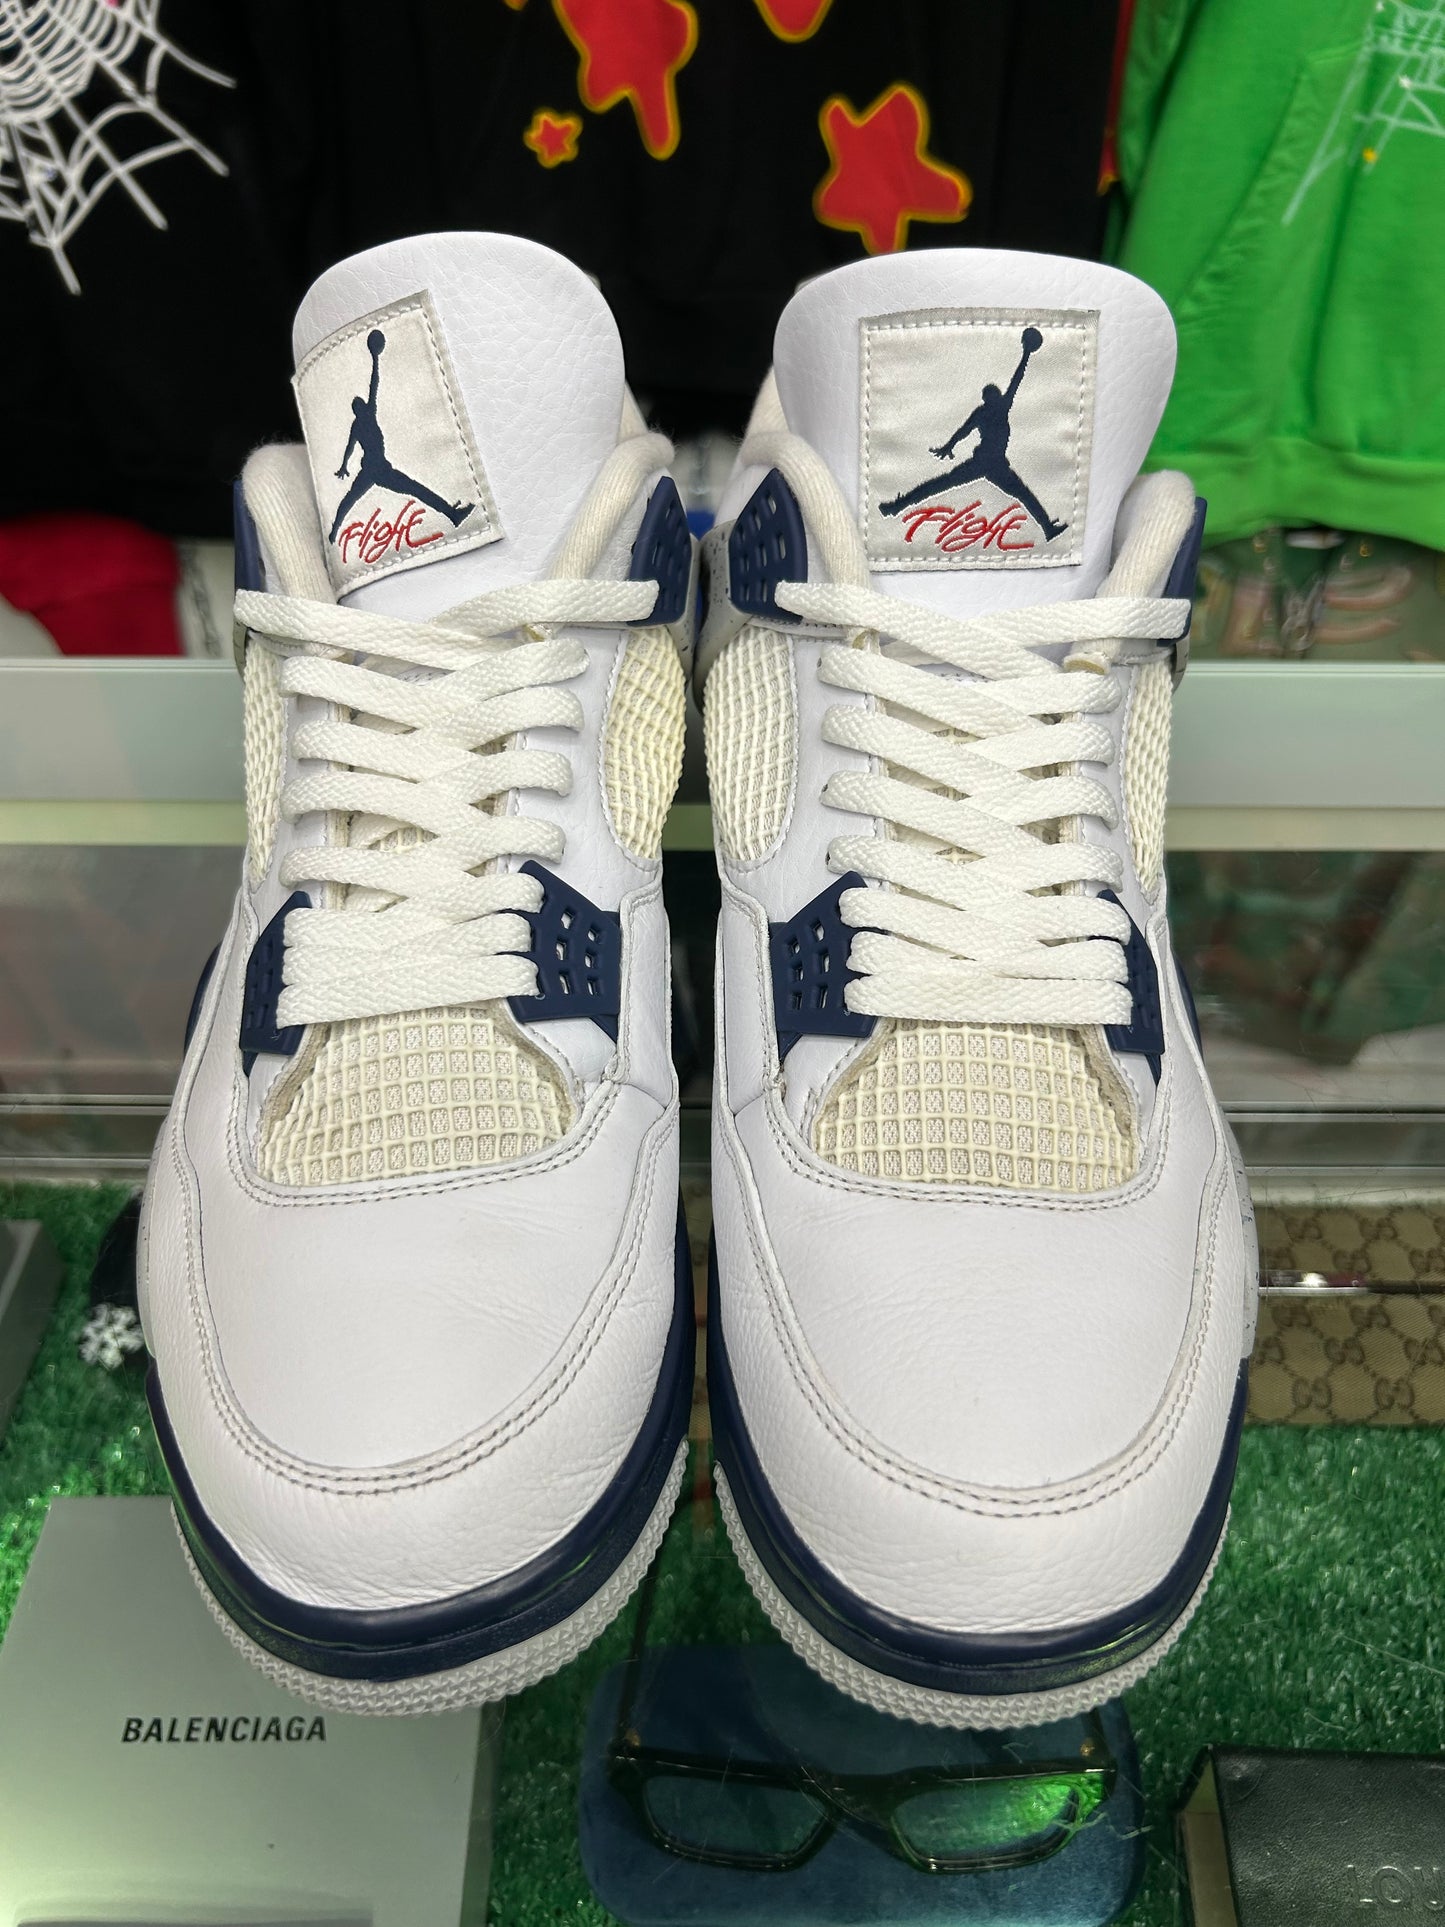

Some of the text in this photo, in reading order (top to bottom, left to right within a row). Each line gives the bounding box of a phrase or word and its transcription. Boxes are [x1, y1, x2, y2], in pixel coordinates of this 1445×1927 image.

[339, 500, 444, 564] Flight
[902, 500, 1035, 552] Flight
[121, 1716, 327, 1743] BALENCIAGA
